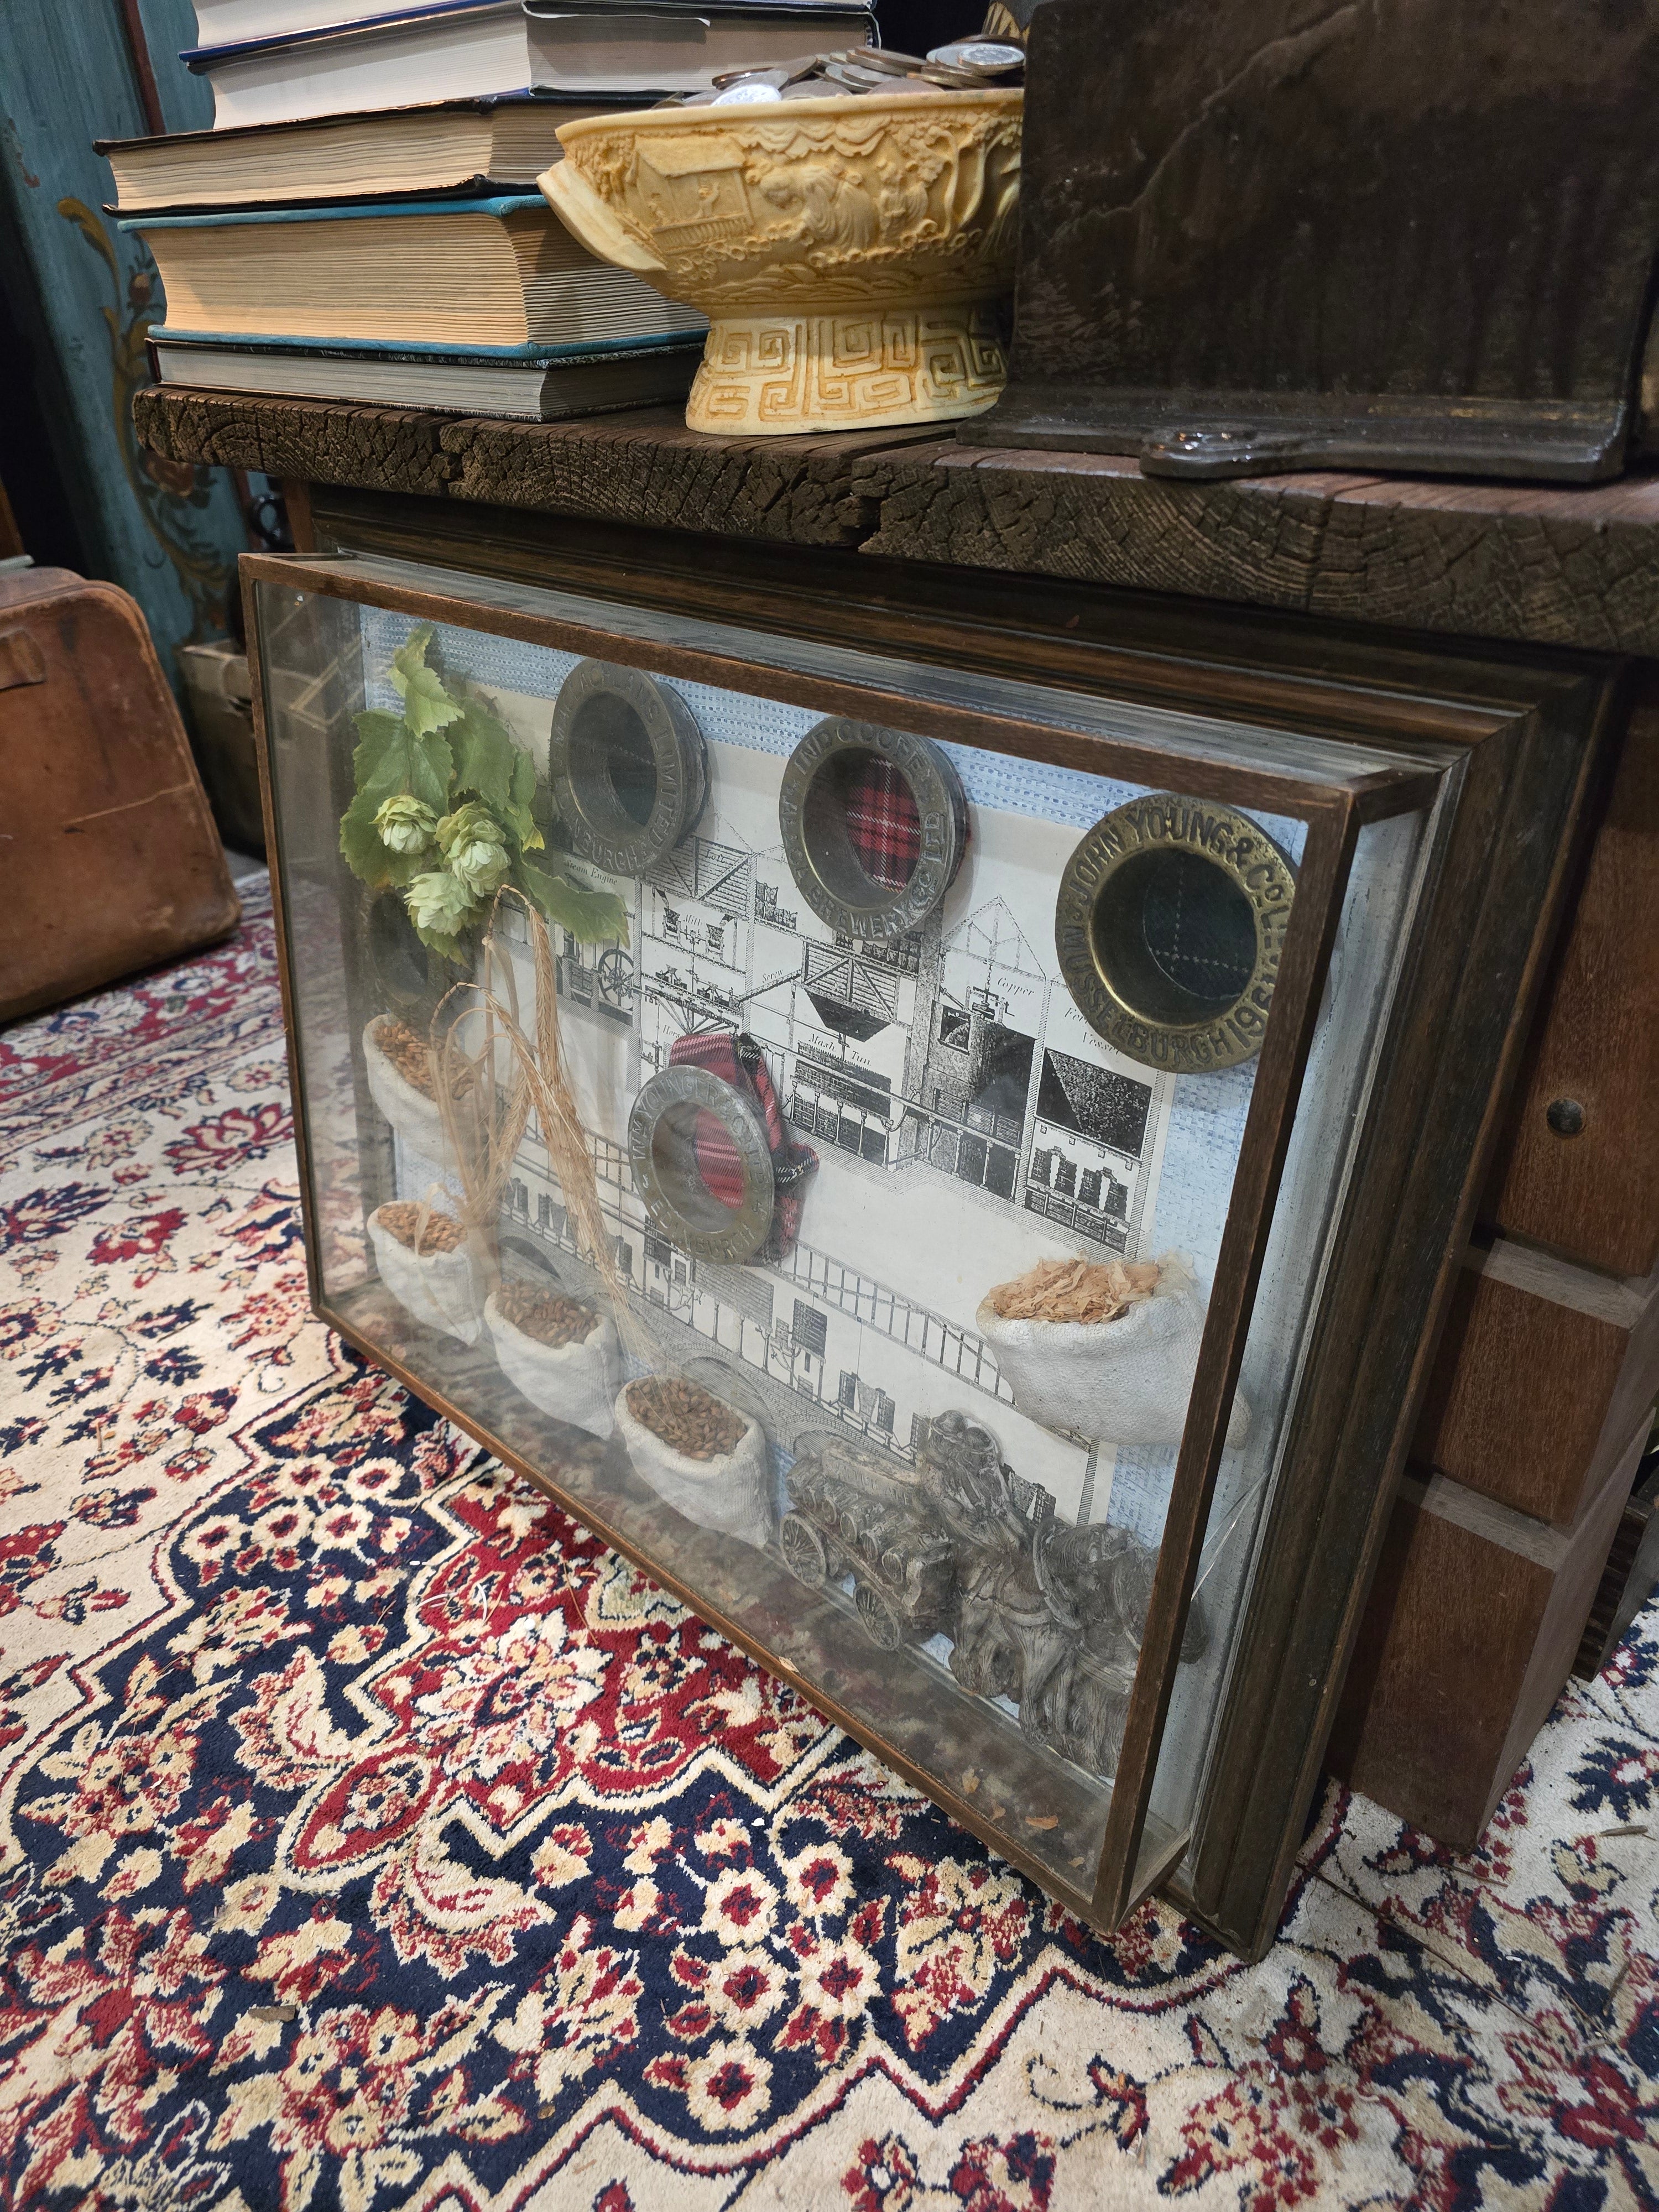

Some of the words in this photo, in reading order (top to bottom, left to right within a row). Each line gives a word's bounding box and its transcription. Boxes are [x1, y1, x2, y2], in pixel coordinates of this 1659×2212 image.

[795, 728, 833, 775] IND
[836, 722, 926, 776] COOPE
[648, 732, 682, 848] LIMITED
[1125, 807, 1234, 855] YOUNG
[565, 859, 588, 875] Steam
[590, 867, 618, 885] Engine
[805, 885, 913, 938] BREWERY
[762, 969, 784, 983] Screw
[997, 977, 1035, 996] Copper
[1062, 925, 1233, 1066] MUSSELBURGH
[662, 1024, 684, 1039] Hors
[808, 1033, 836, 1052] Mash
[852, 1050, 872, 1066] Tun
[635, 1073, 721, 1119] YOUNGER
[650, 1199, 758, 1260] EDINBURGH
